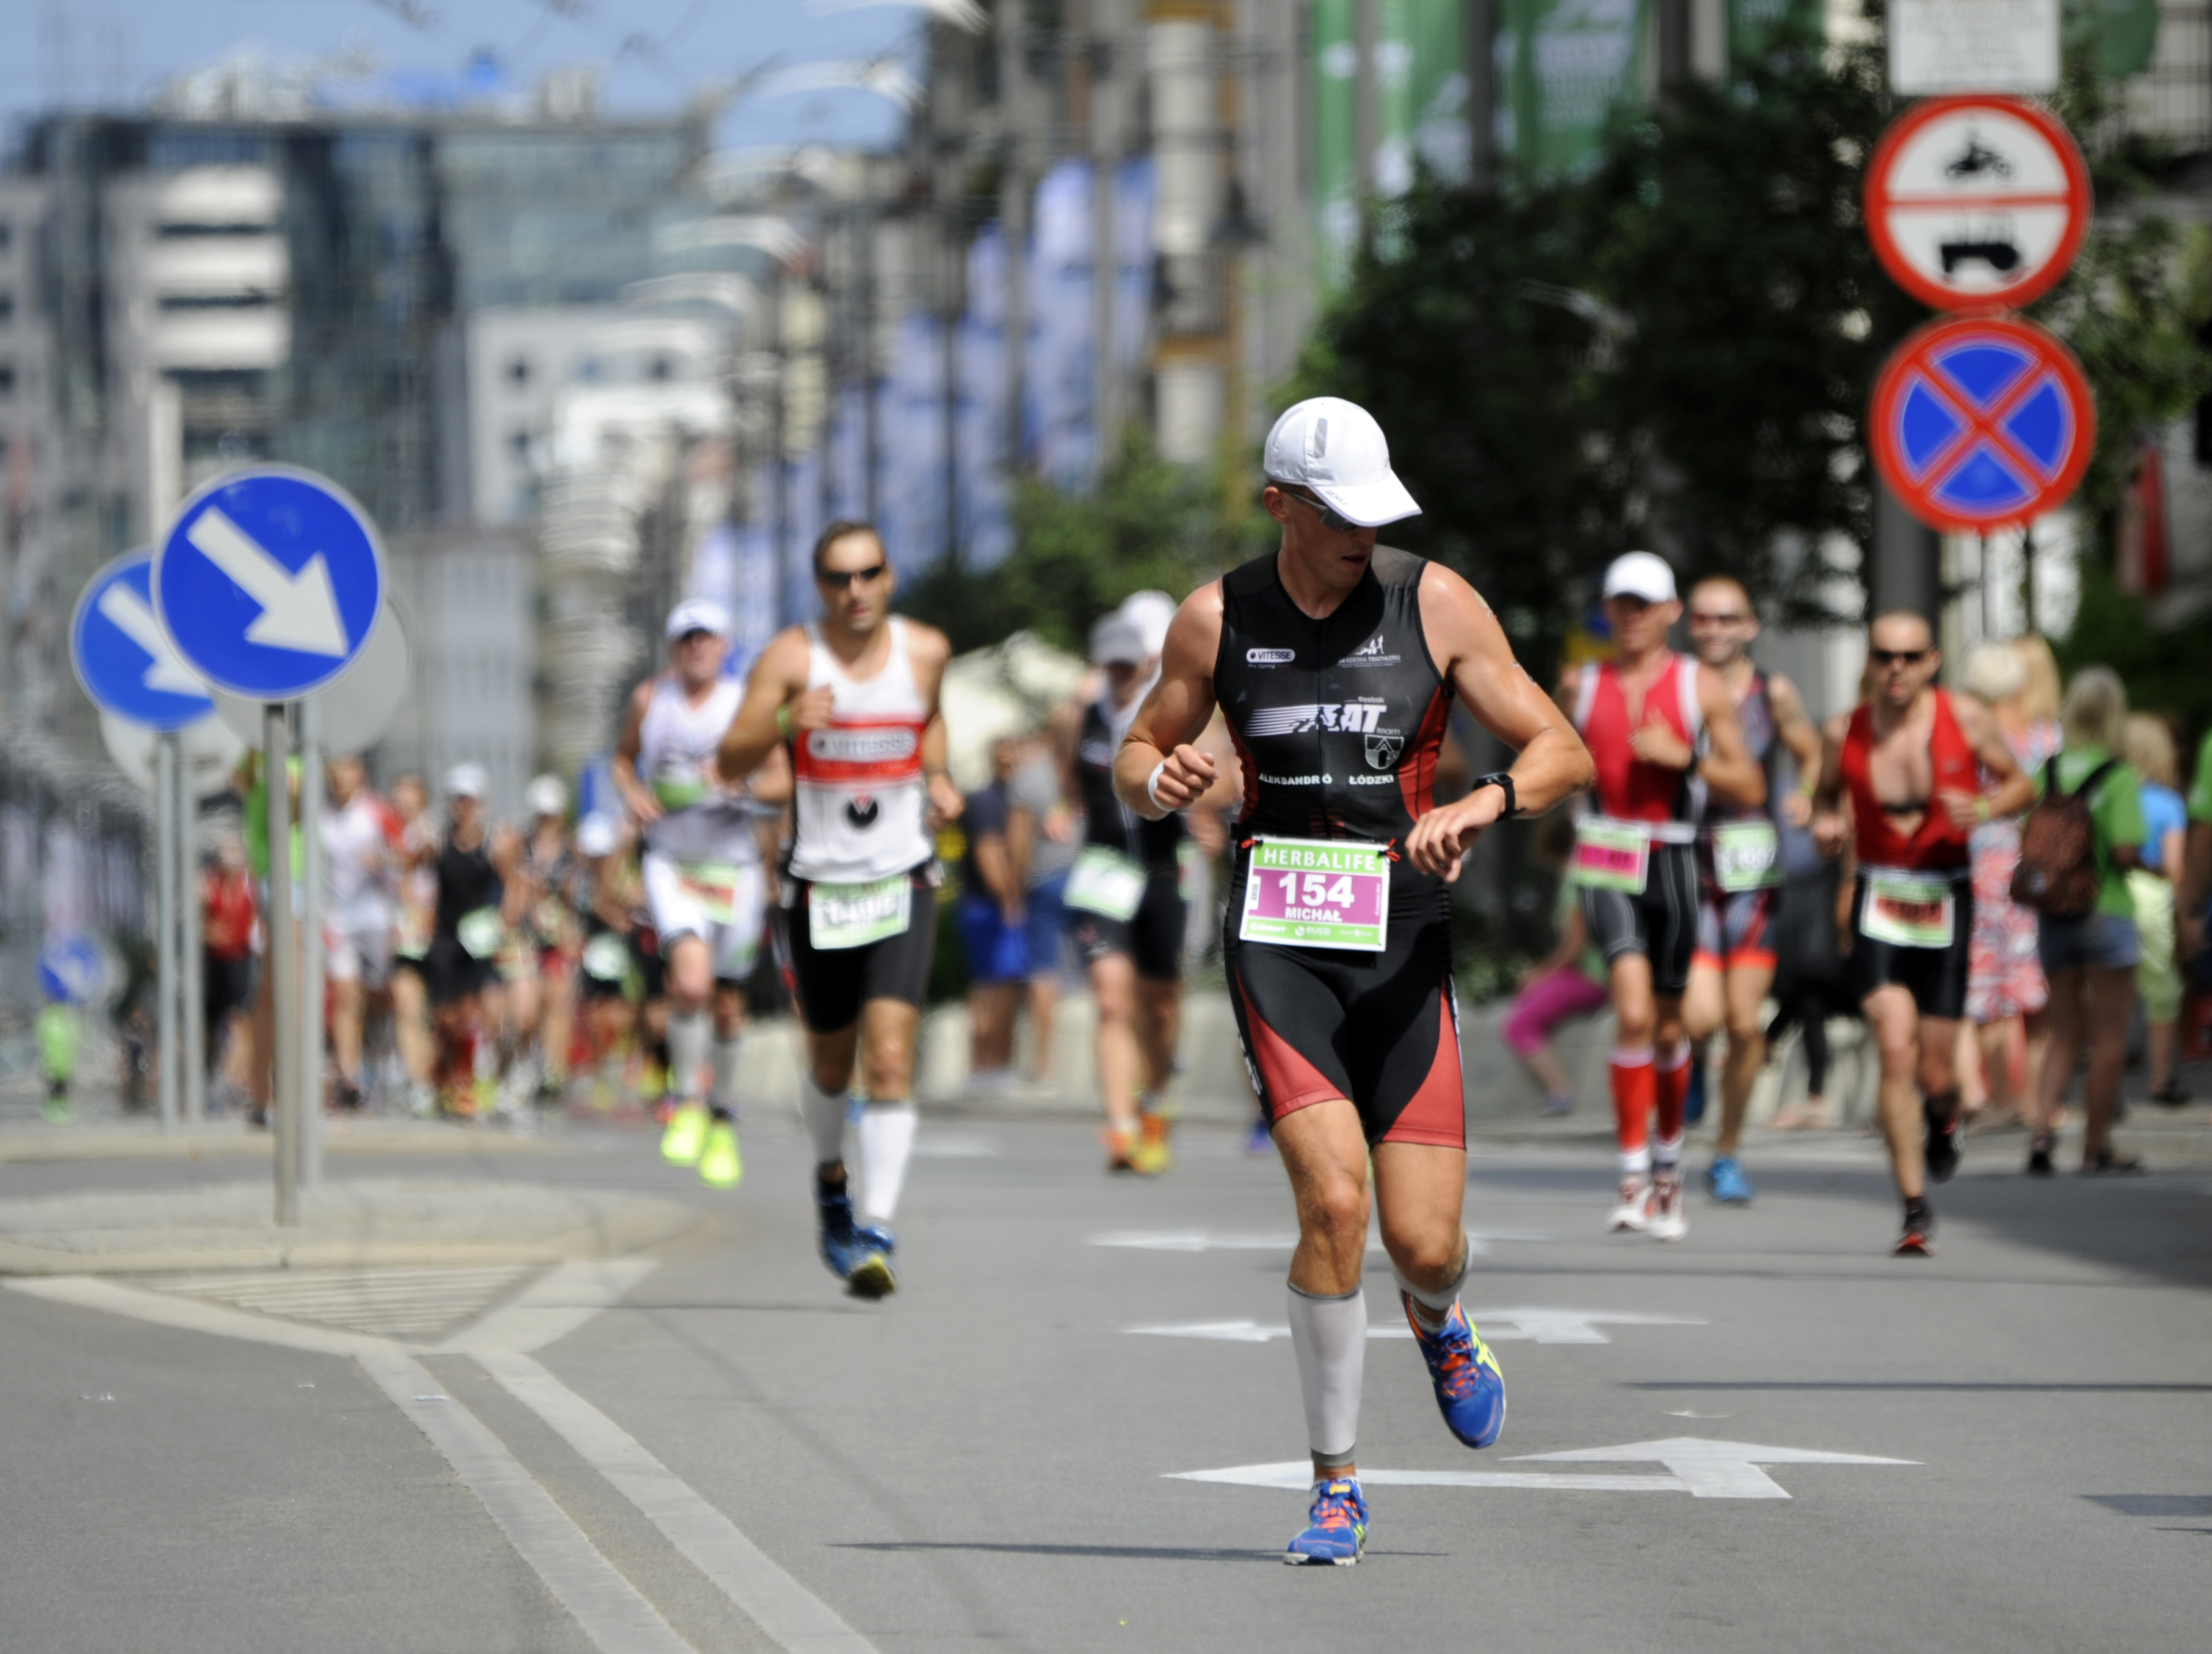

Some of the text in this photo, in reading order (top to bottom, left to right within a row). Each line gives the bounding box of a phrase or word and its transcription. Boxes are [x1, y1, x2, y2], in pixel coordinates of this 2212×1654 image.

[1349, 774, 1394, 785] ŁÓDZKI
[1263, 848, 1375, 871] HERBALIFE
[1279, 873, 1355, 908] 154
[1285, 906, 1343, 922] MICHAŁ
